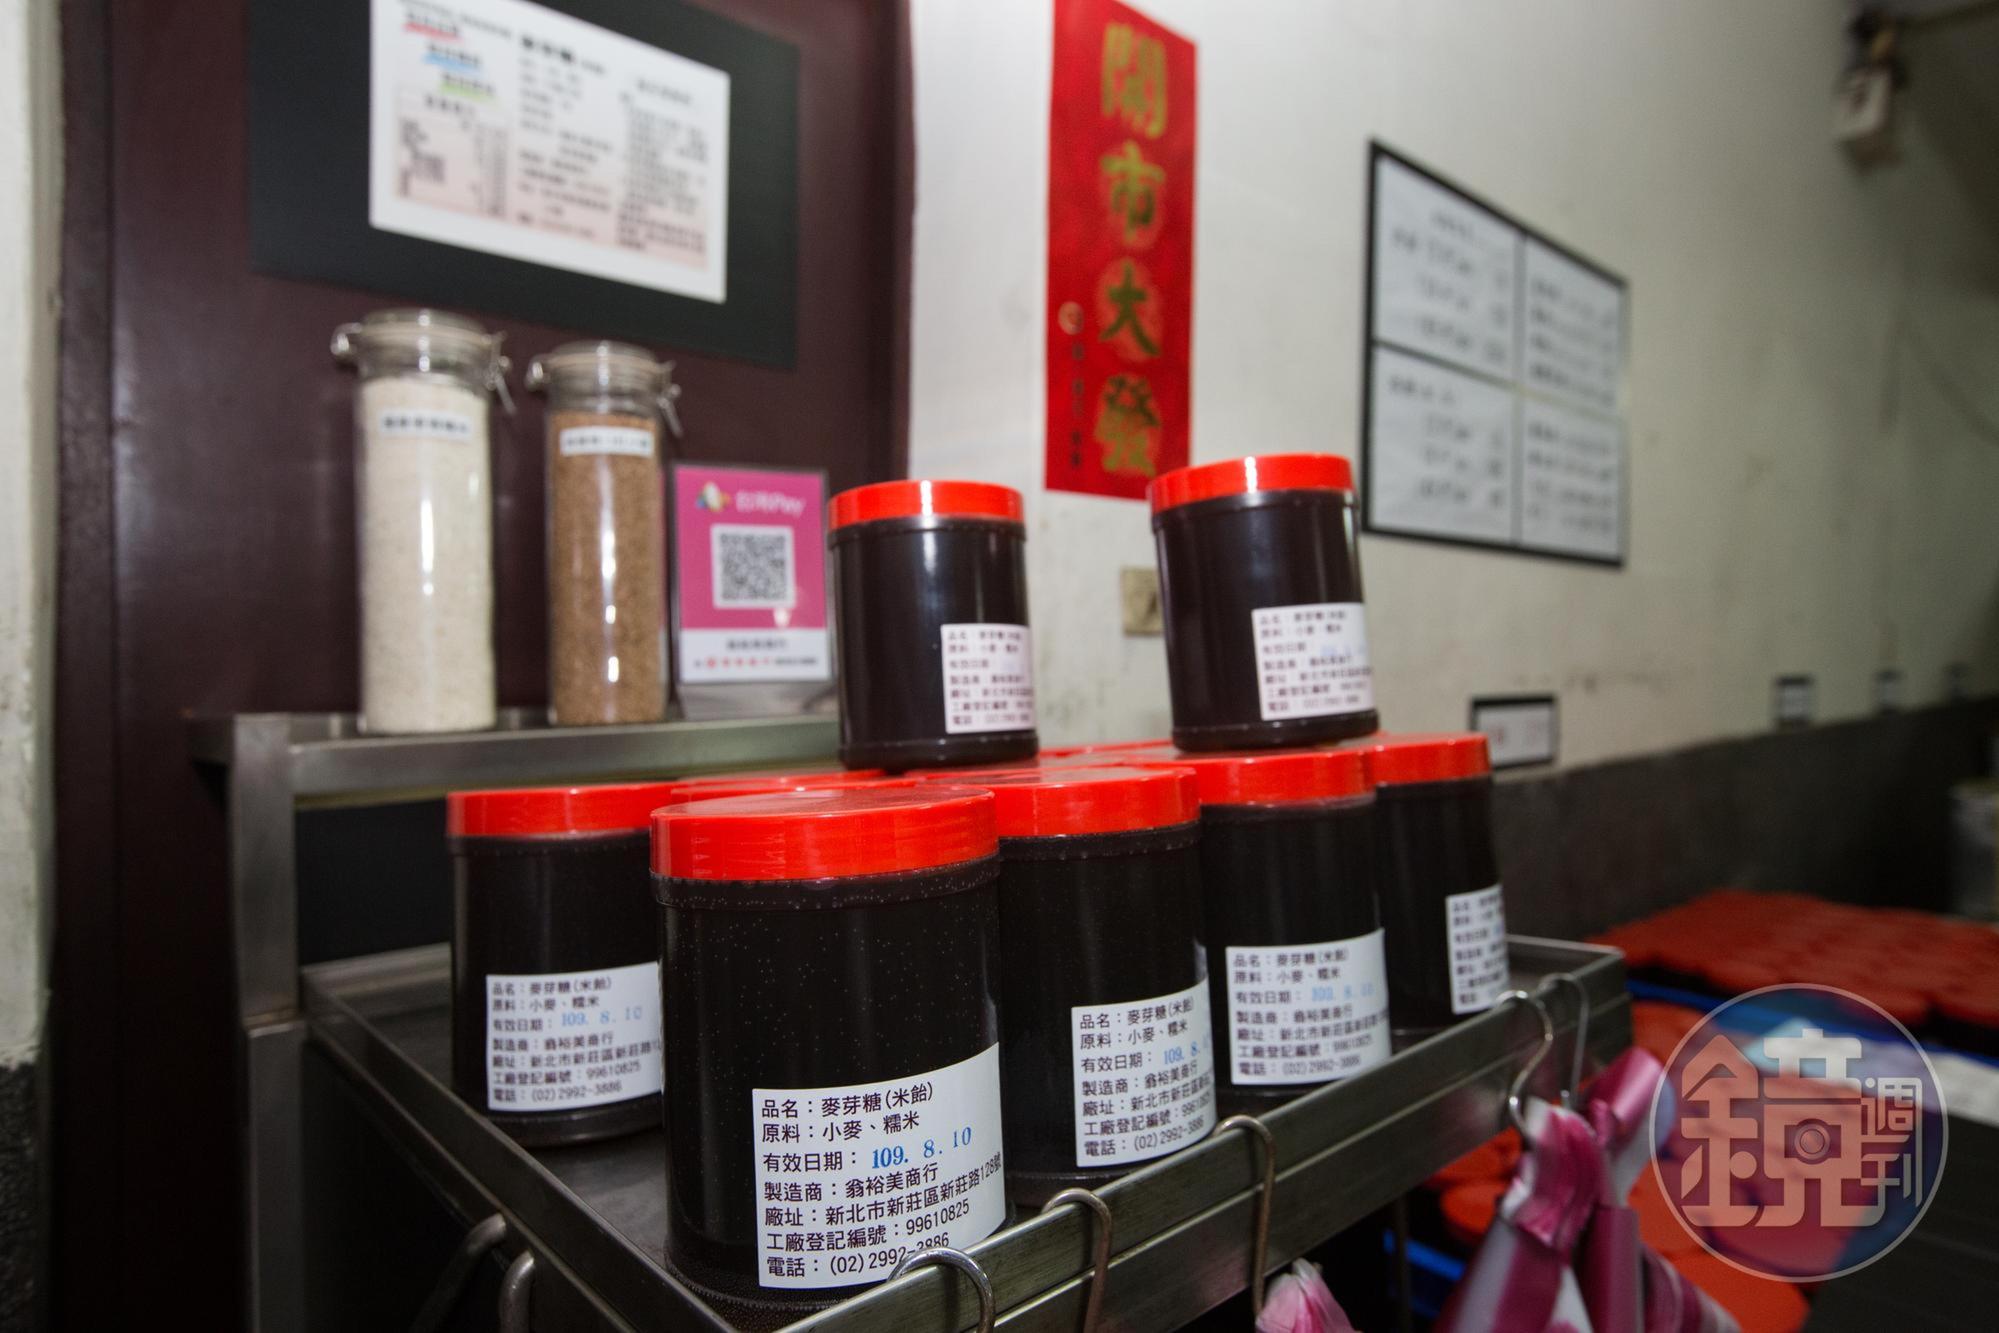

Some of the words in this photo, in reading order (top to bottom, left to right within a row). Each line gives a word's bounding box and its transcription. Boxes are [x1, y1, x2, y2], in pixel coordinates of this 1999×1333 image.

[761, 1082, 933, 1119] 品名：麥芽糖(米飴)
[762, 1111, 920, 1143] 原料：小麥、糯米
[763, 1151, 858, 1172] 有效日期：
[872, 1146, 909, 1169] 109.
[953, 1127, 971, 1148] 10
[764, 1162, 938, 1202] 製造商：翁裕美商行
[766, 1198, 969, 1252] 工廠登記編號：99610825
